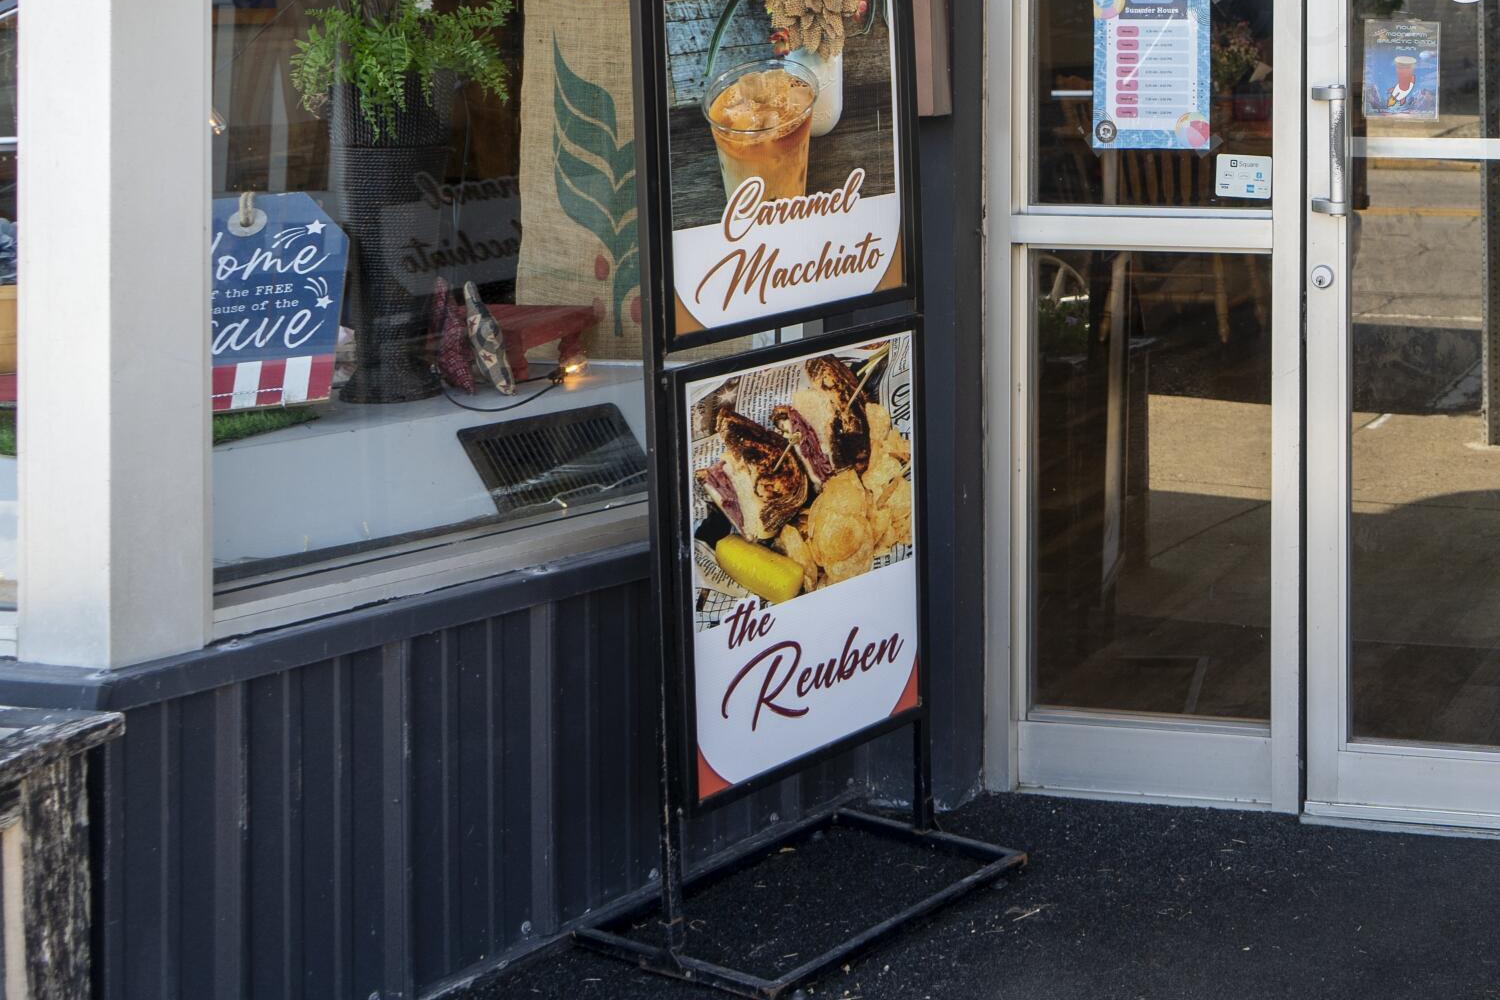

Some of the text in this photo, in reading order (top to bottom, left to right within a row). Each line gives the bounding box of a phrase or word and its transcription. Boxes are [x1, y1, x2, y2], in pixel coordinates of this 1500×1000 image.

[724, 171, 862, 242] Caramel
[212, 232, 331, 281] ome
[695, 232, 885, 311] Macchiato
[212, 299, 299, 315] ause of the
[225, 288, 249, 298] the
[255, 283, 293, 296] FREE
[724, 600, 776, 649] the
[721, 626, 904, 731] Reuben
